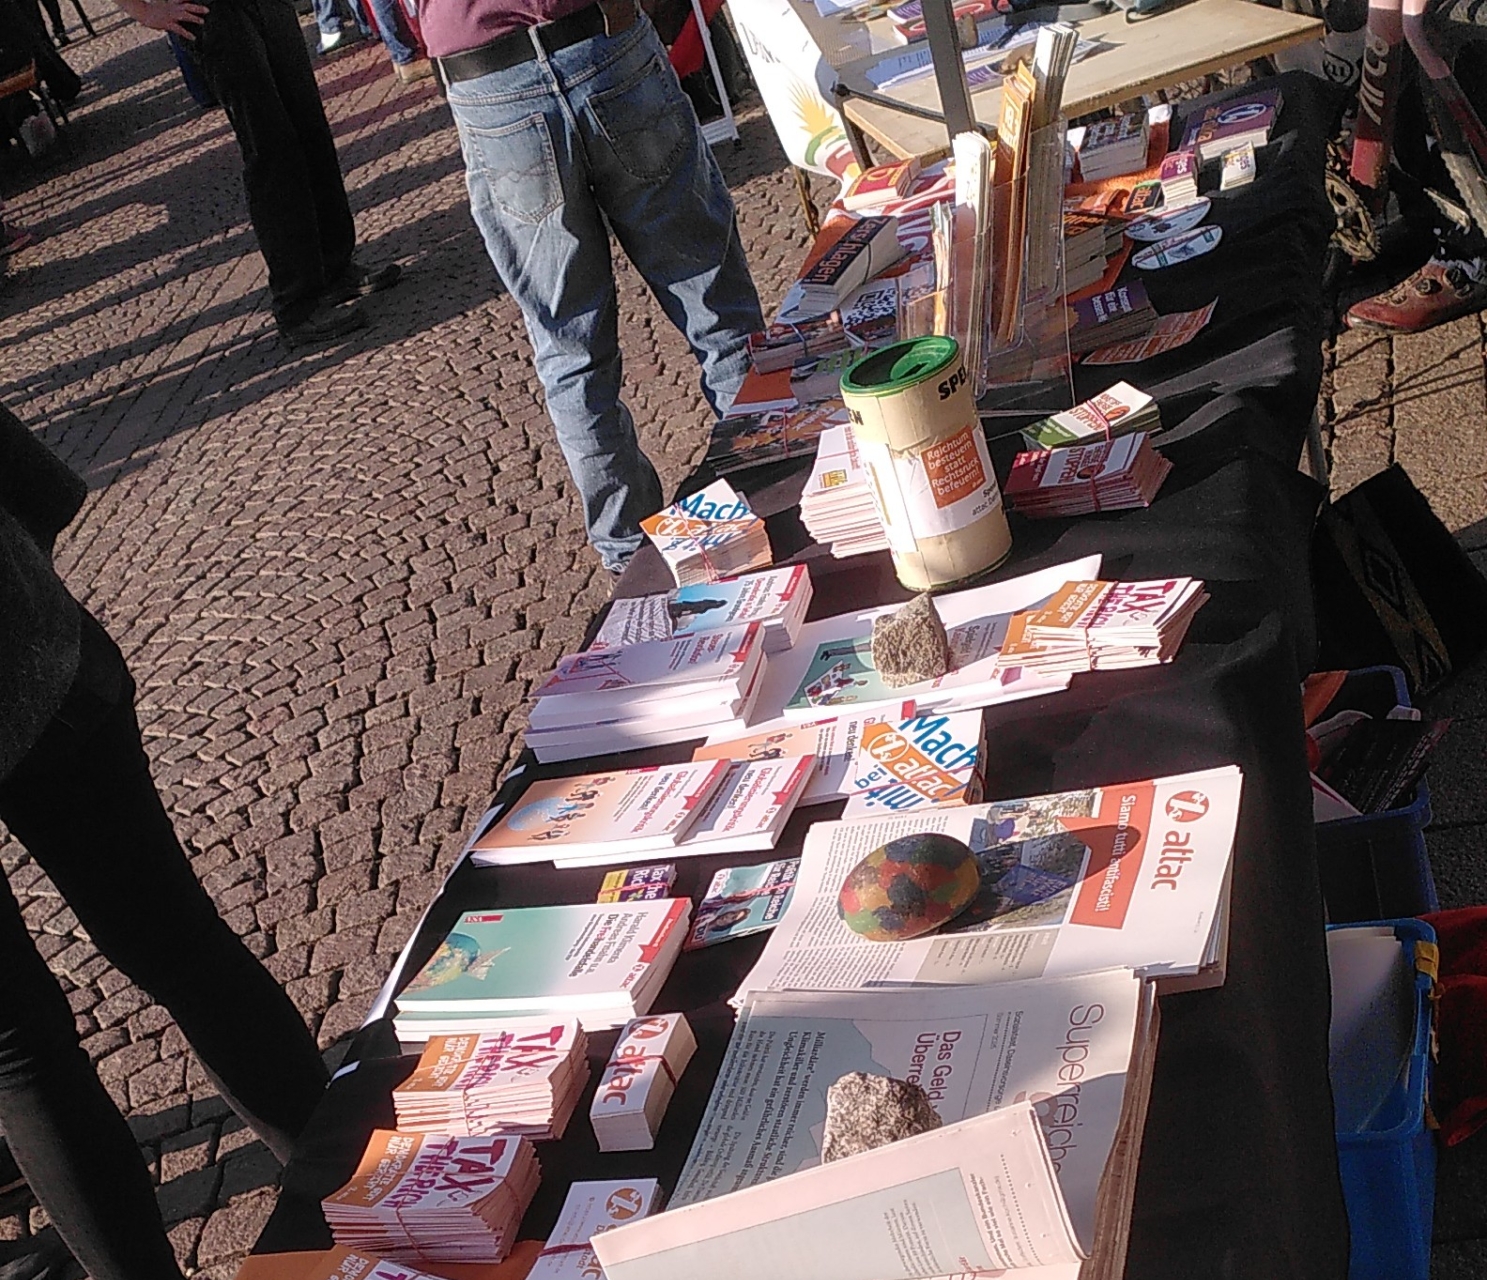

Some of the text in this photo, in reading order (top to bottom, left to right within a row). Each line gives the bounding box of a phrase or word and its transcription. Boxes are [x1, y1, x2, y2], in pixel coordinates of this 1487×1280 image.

[926, 432, 970, 462] Reichtum
[928, 441, 973, 470] besteuern
[931, 457, 980, 488] Rechtsruck
[944, 457, 966, 472] statt
[936, 466, 981, 496] befeuern!
[670, 494, 751, 520] Mach
[1117, 580, 1178, 614] TAX
[897, 715, 981, 769] Mach
[1094, 794, 1137, 912] Siamo tutti antifascisti!
[1150, 830, 1196, 891] attac
[648, 865, 671, 883] Tax
[645, 880, 664, 900] the
[603, 913, 620, 926] Die
[608, 912, 633, 941] Andreas
[607, 911, 649, 963] Harald Klimenta
[505, 1025, 566, 1071] TAX
[929, 1031, 961, 1100] Das Geld
[434, 1139, 510, 1196] TAX
[337, 1253, 360, 1273] NUR
